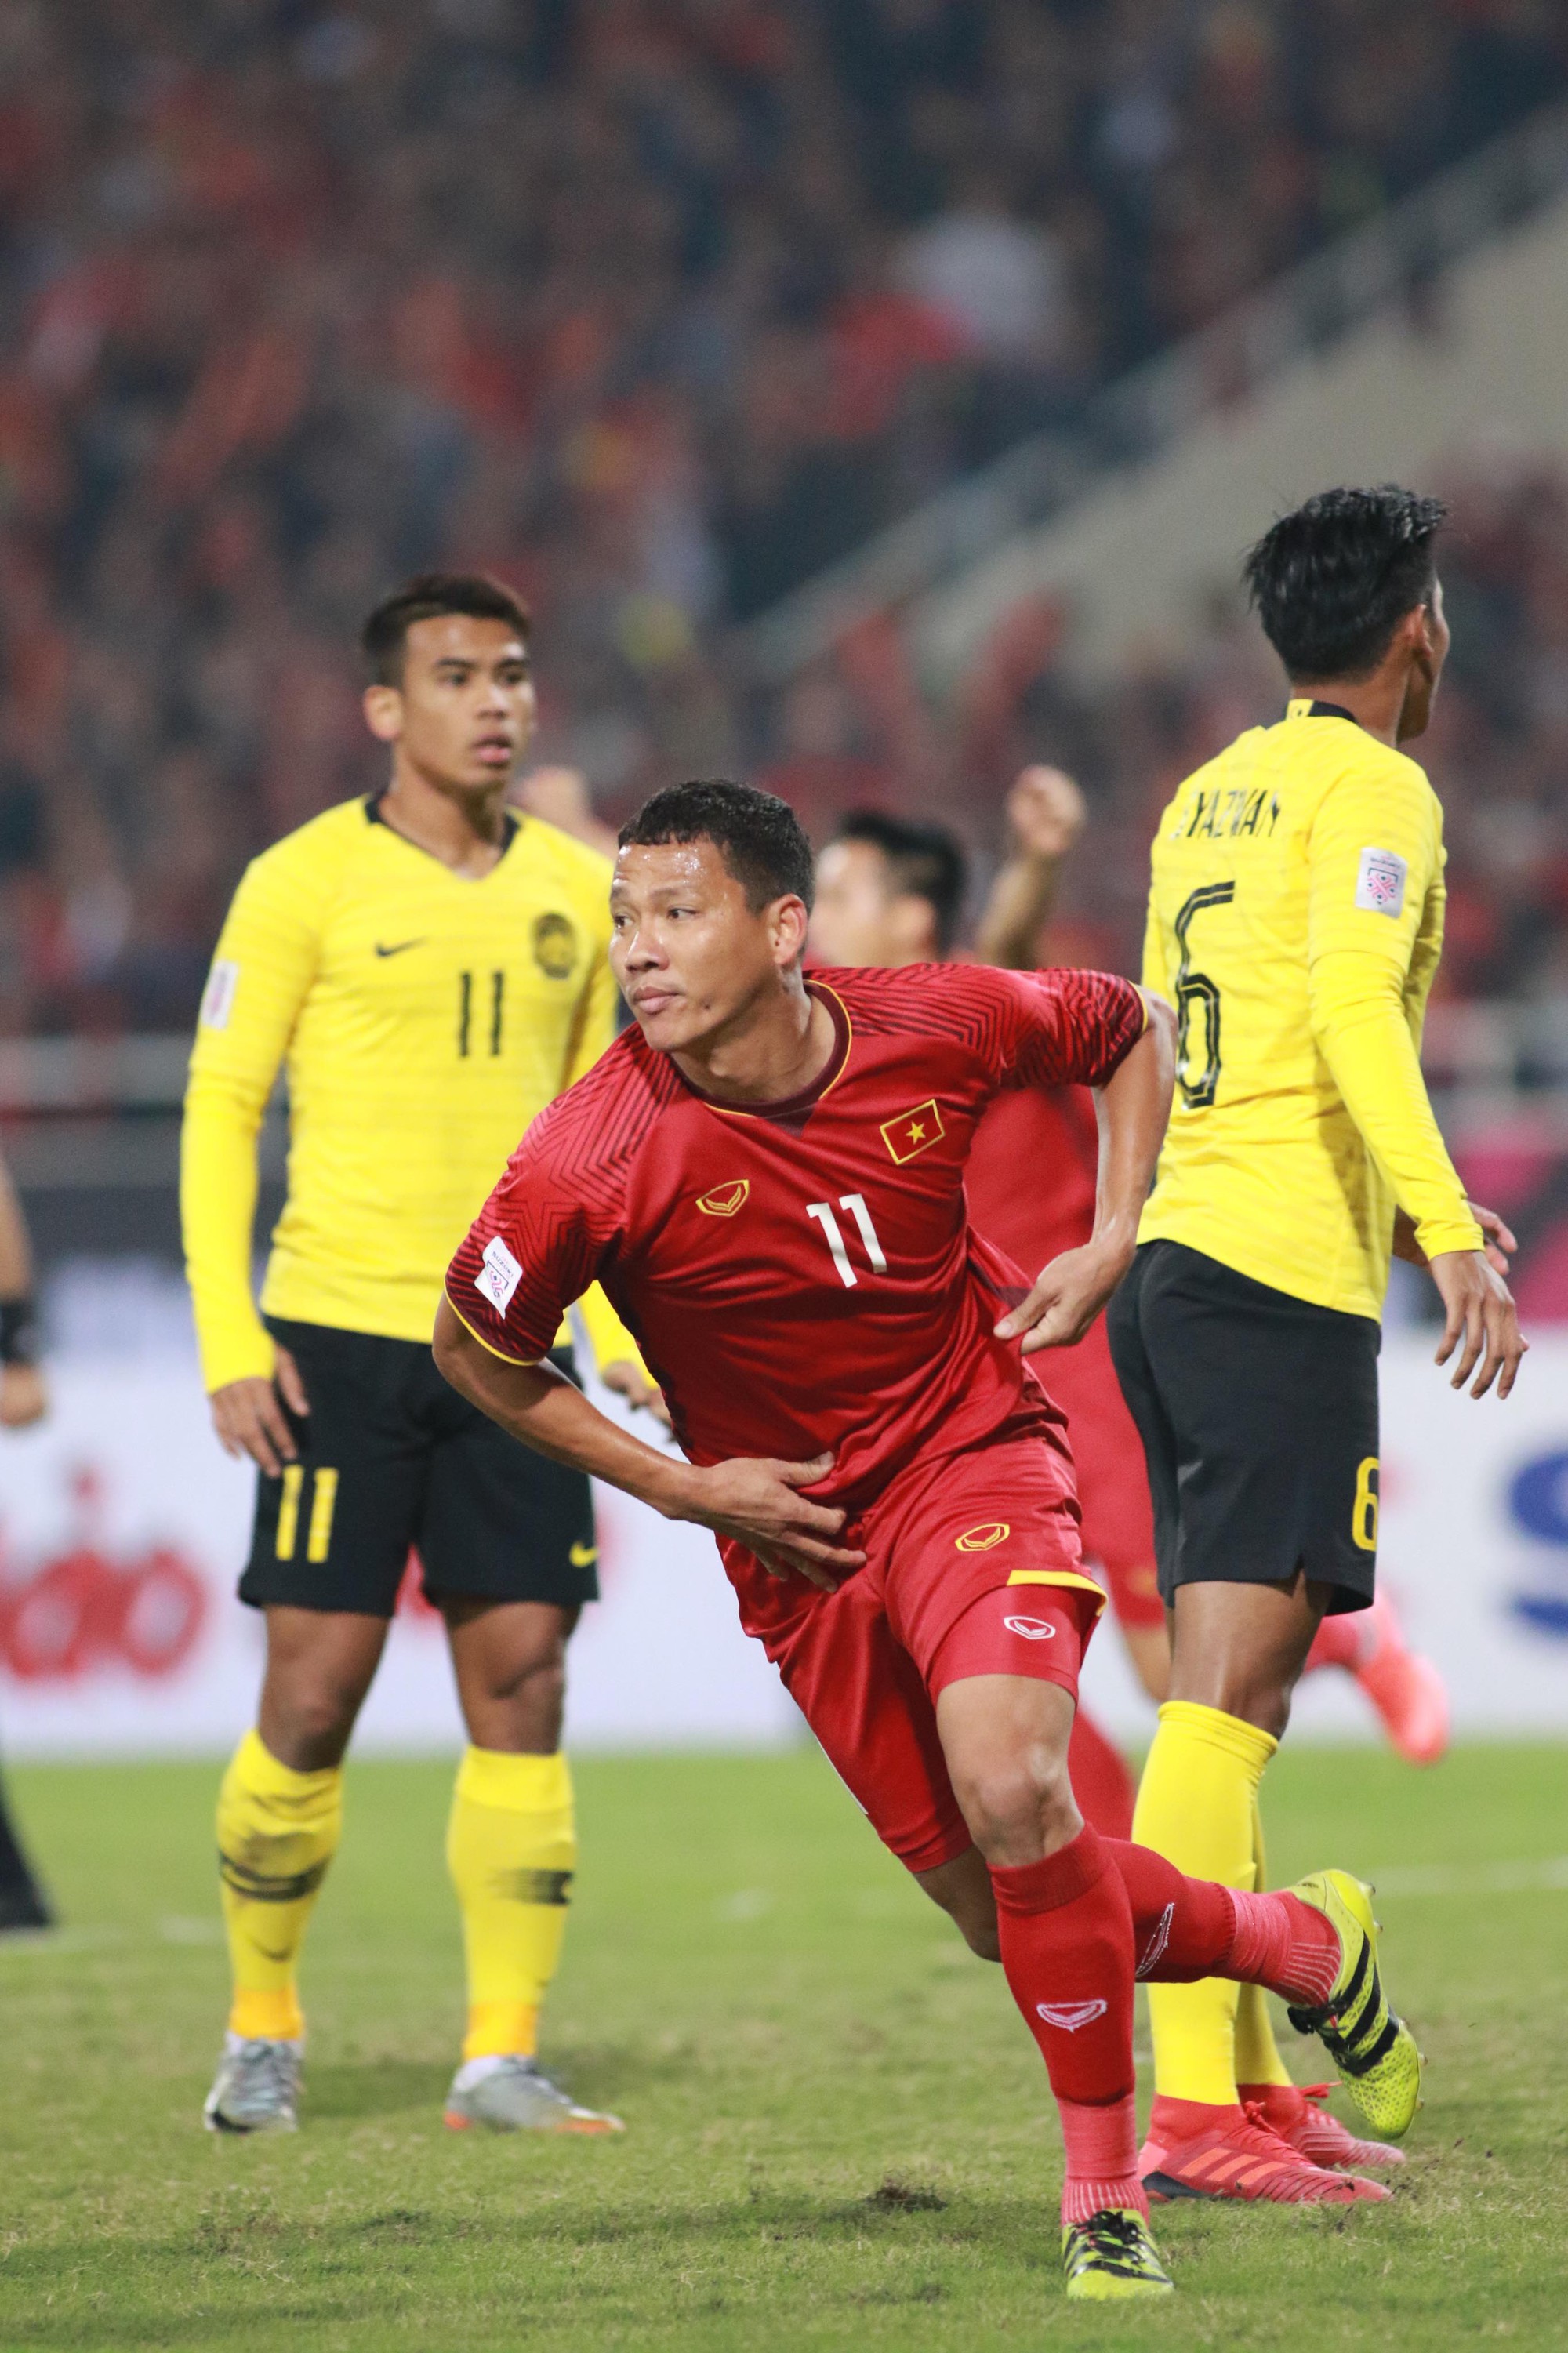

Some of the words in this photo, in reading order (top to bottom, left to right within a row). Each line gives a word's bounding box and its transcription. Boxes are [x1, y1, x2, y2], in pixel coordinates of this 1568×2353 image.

[458, 970, 503, 1058] 11
[1175, 880, 1236, 1109] 6
[806, 1193, 887, 1288] 11
[275, 1465, 339, 1563] 11
[1352, 1456, 1379, 1552] 6
